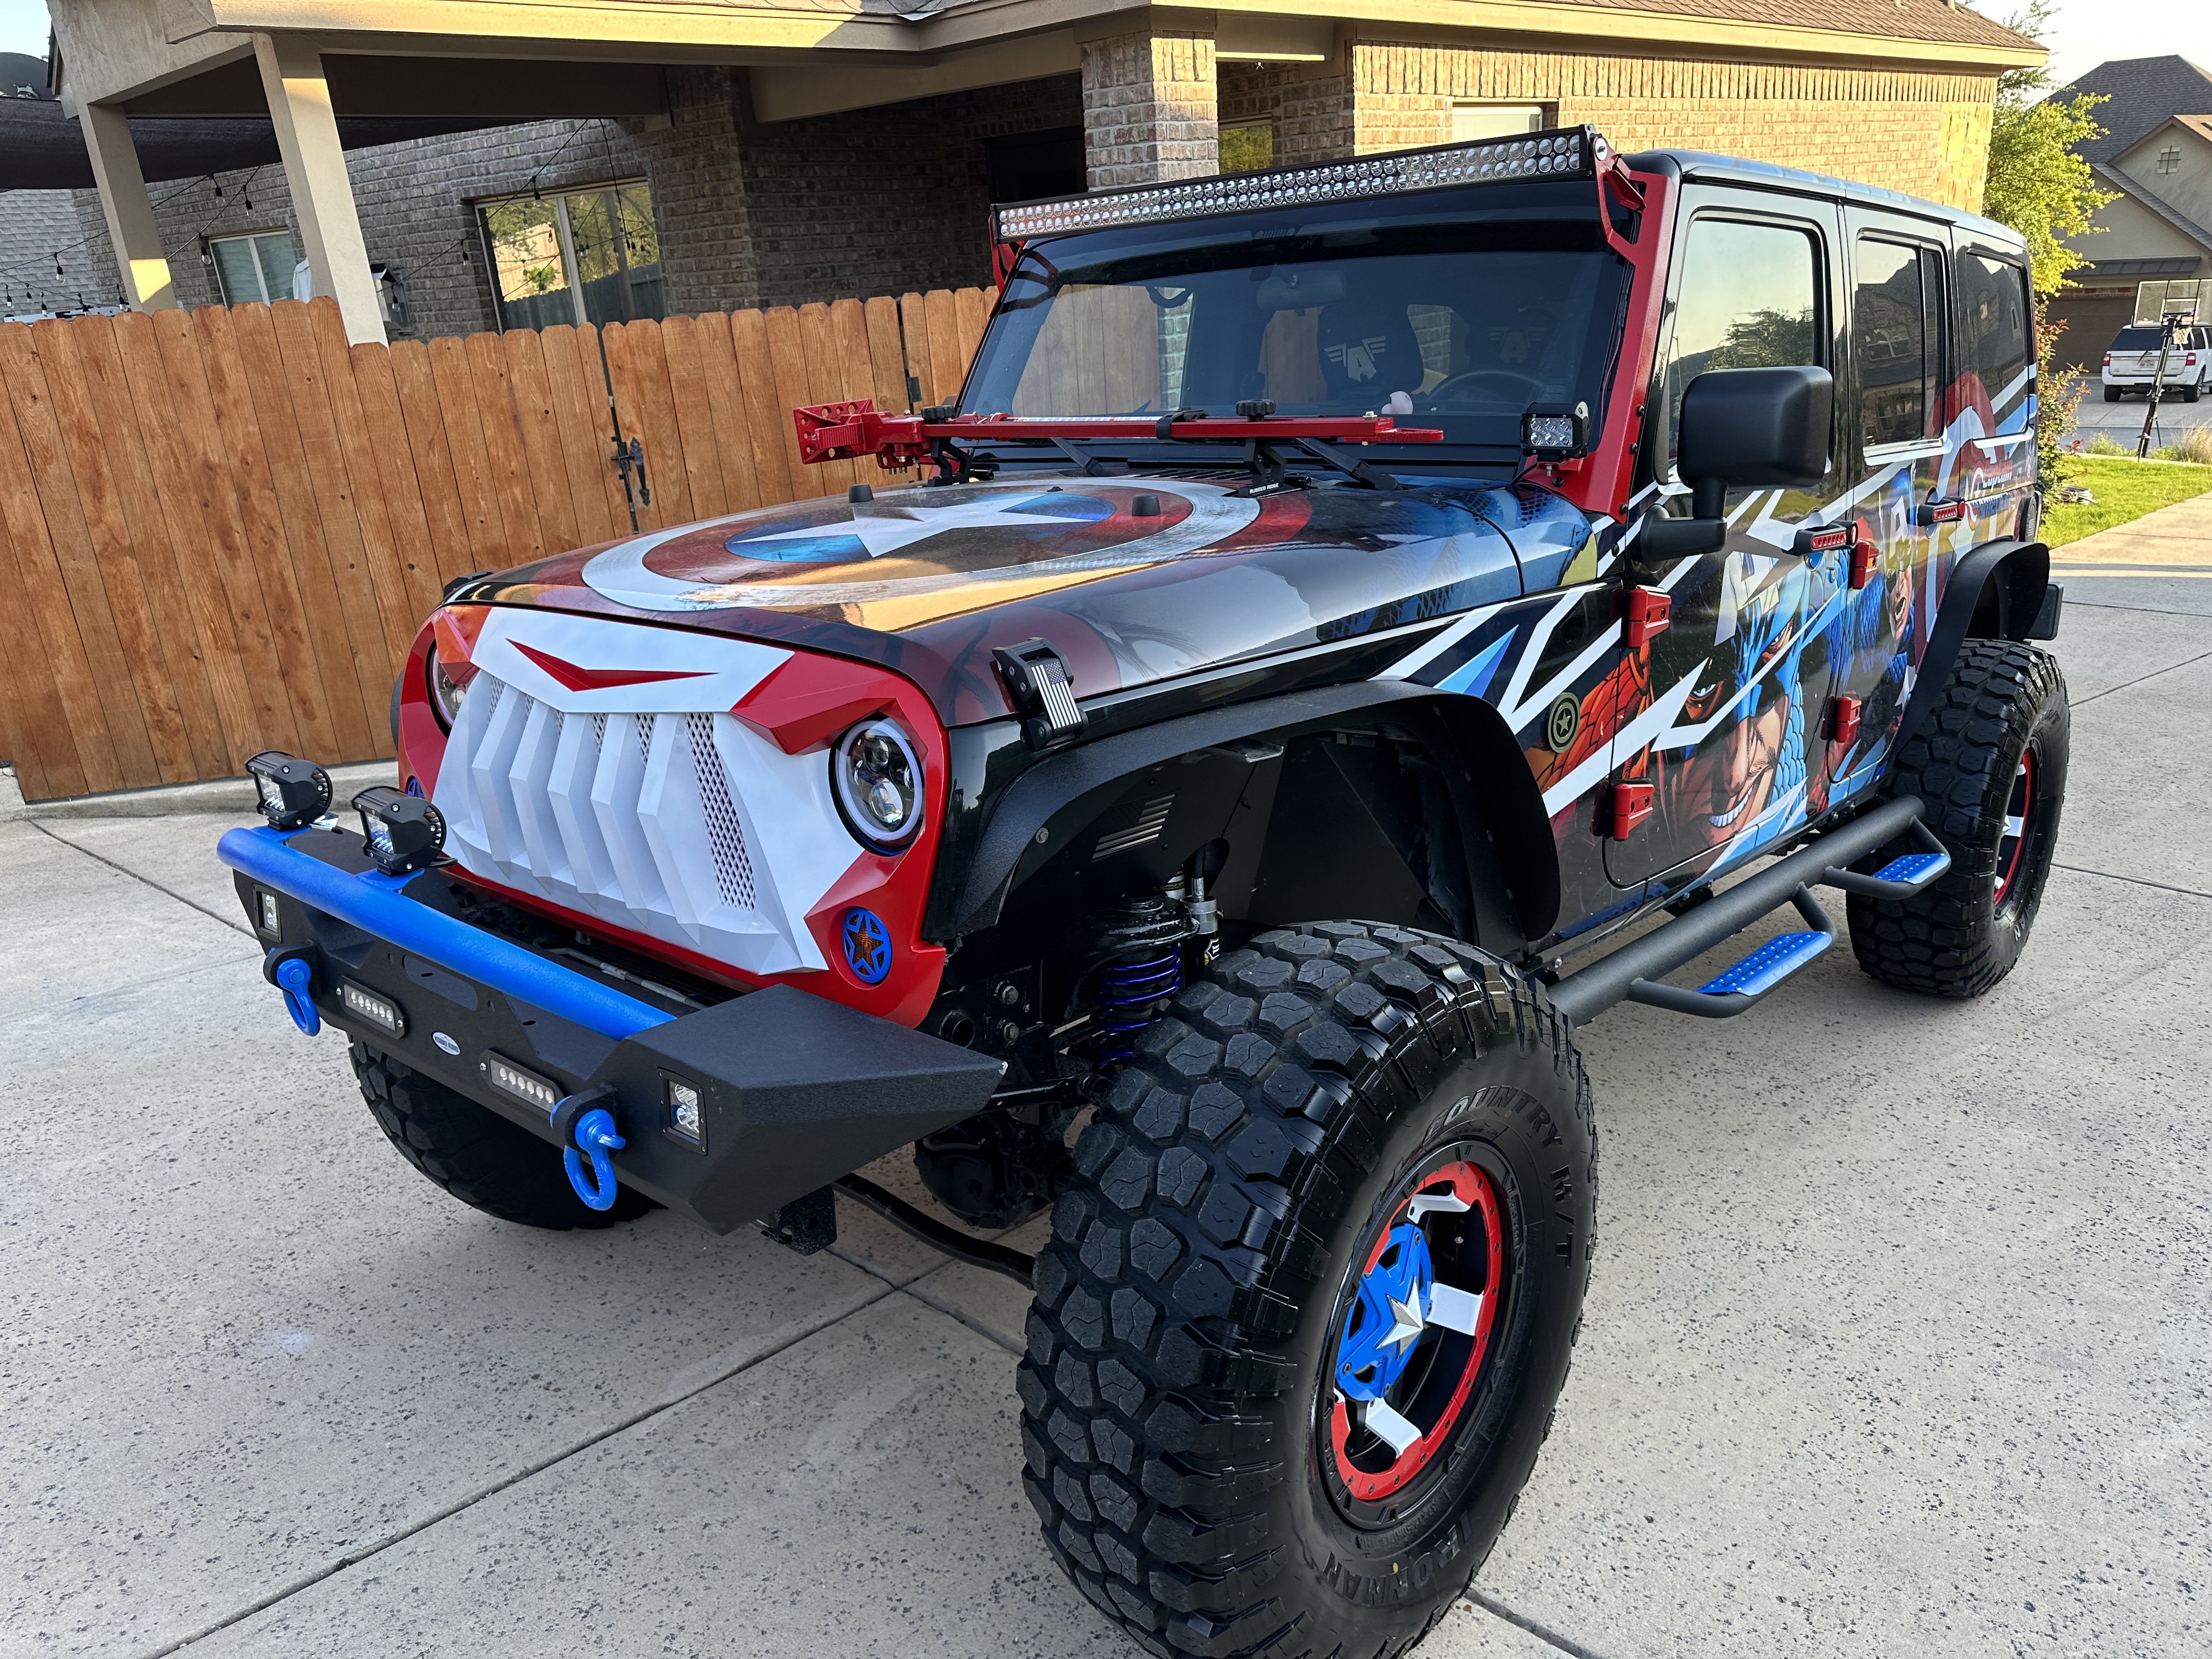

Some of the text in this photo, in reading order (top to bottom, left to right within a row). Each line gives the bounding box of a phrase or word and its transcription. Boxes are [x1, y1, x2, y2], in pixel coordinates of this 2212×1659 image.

[1347, 346, 1376, 382] A
[1421, 1085, 1564, 1149] COUNTRY
[1551, 1164, 1575, 1268] M/T
[1322, 1510, 1473, 1607] IRONMAN
